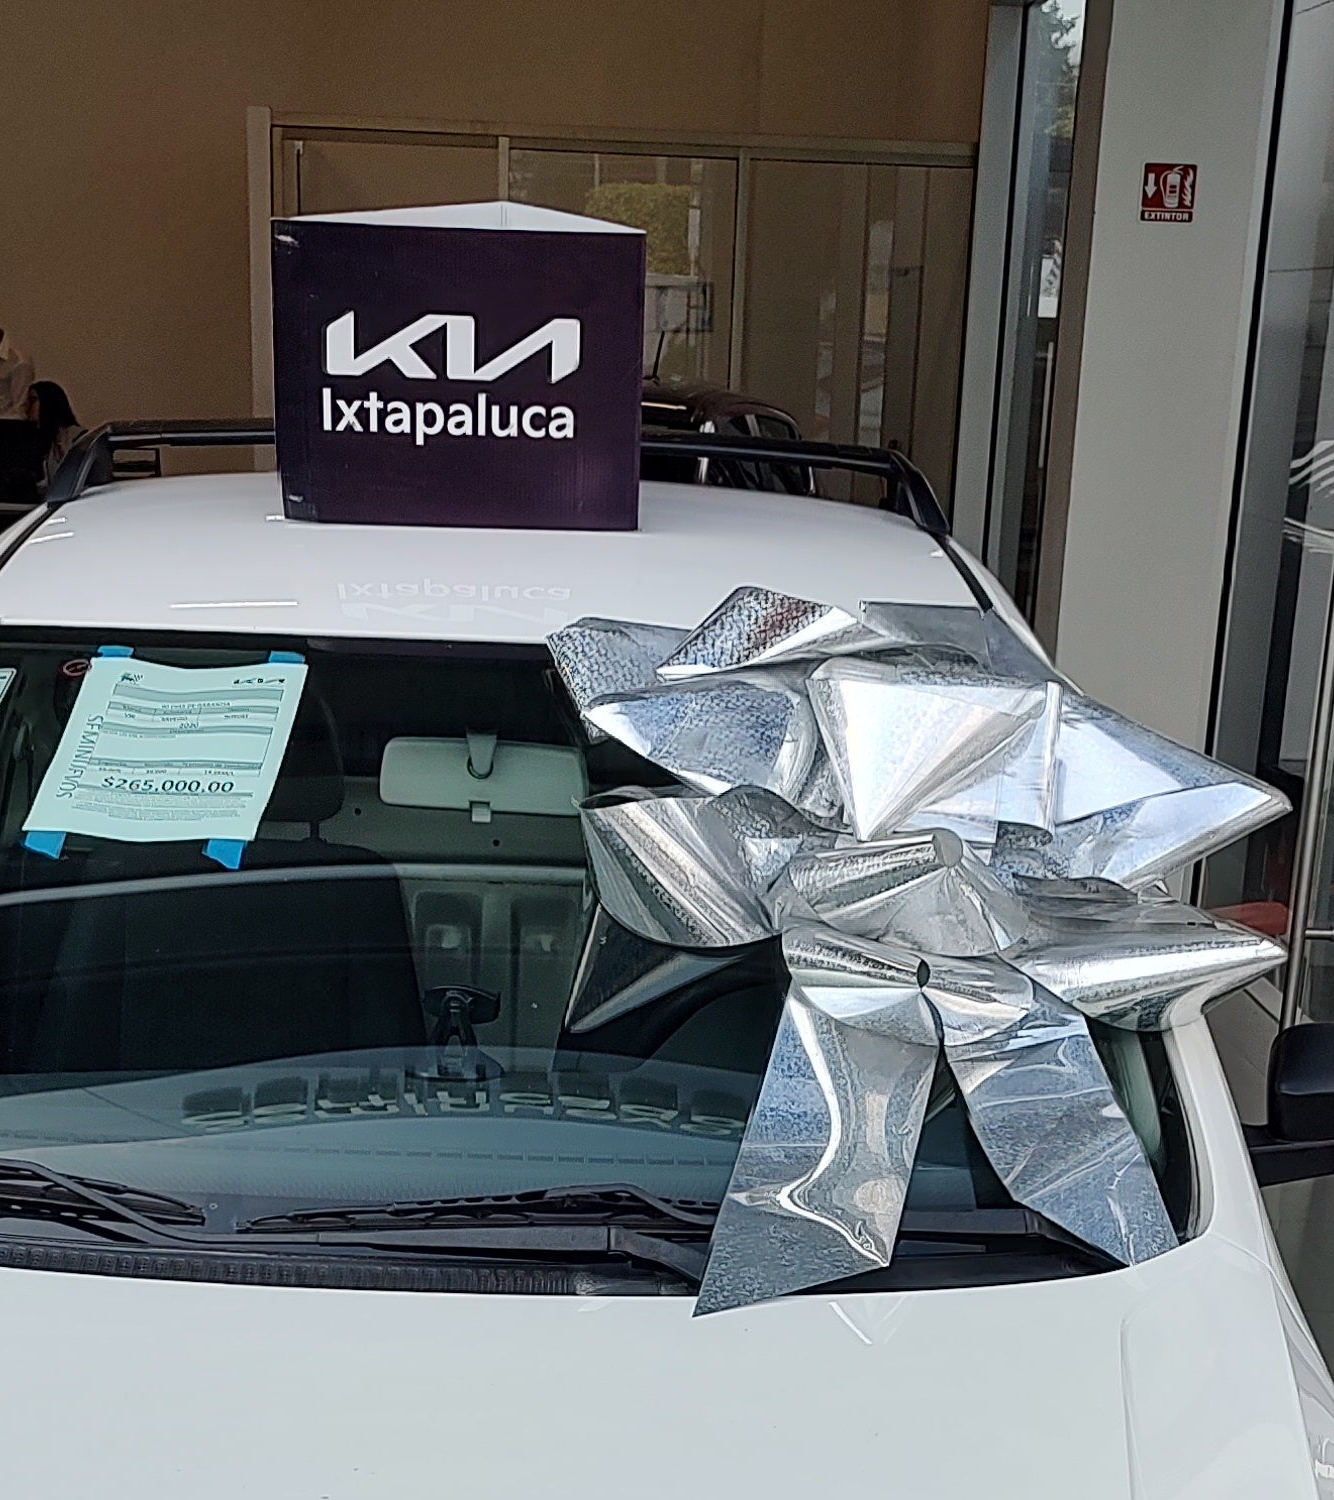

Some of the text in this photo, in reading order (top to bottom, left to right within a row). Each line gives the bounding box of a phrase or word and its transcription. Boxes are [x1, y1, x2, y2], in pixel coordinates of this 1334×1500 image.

[1144, 211, 1189, 221] EXTINTOR
[325, 310, 581, 383] KIA
[322, 387, 575, 446] Ixtapaluca
